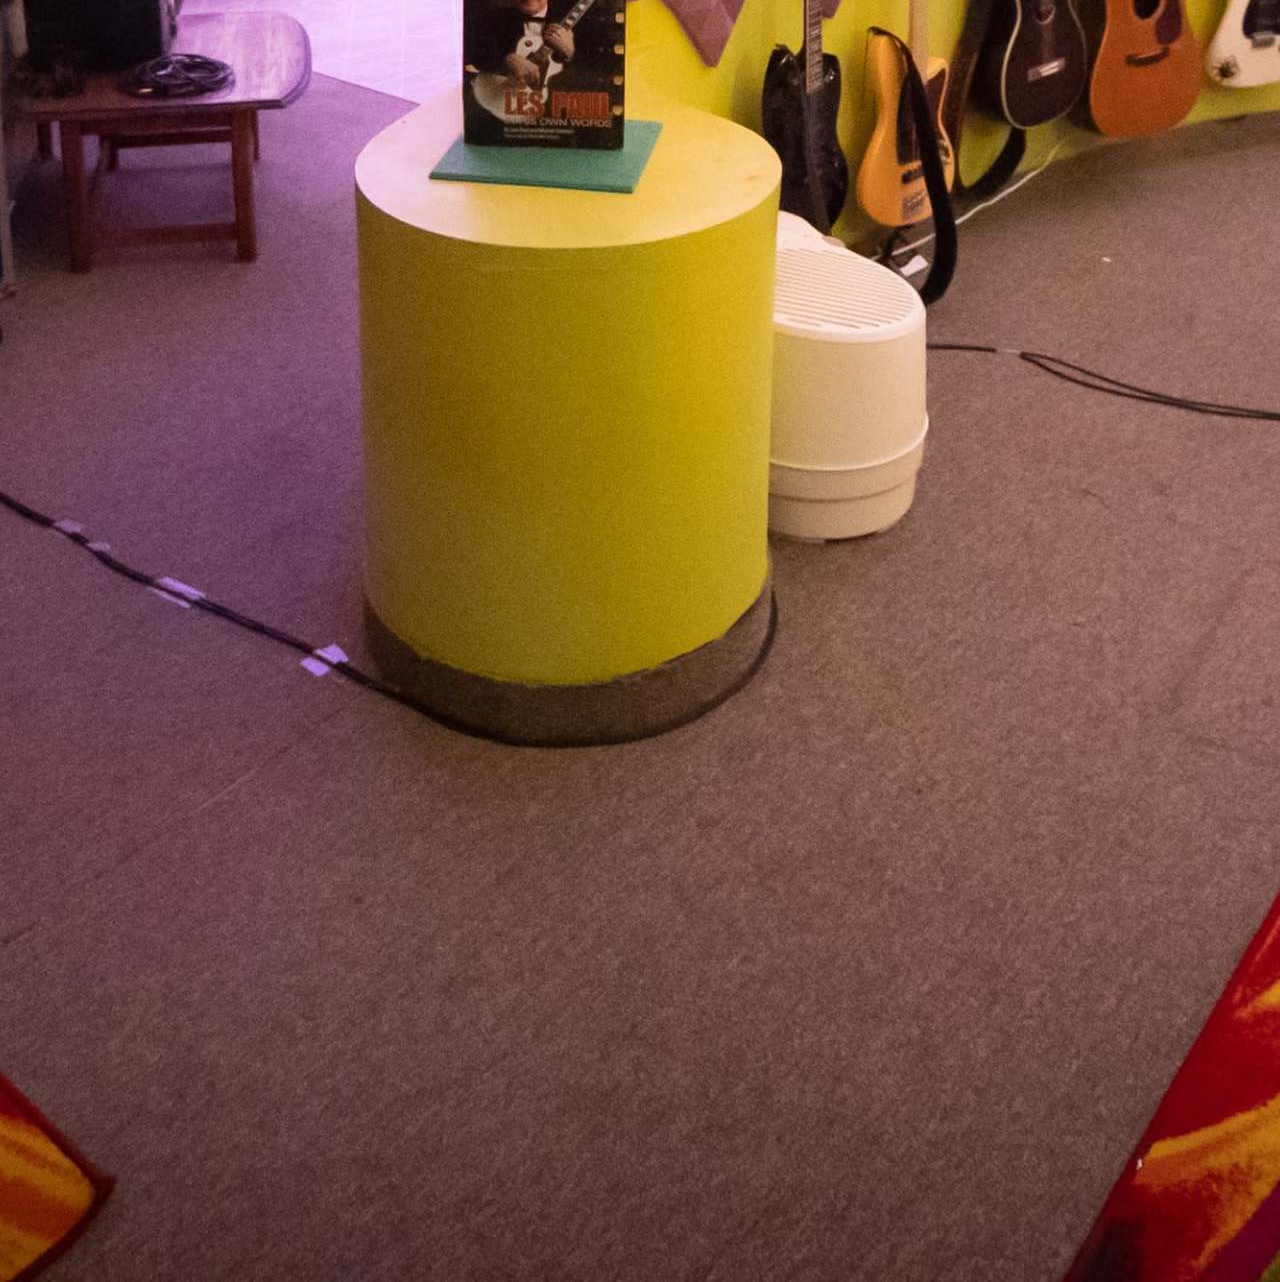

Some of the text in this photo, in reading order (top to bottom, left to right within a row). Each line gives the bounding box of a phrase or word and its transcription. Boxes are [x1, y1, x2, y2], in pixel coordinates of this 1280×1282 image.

[504, 91, 609, 119] LES PAUL
[539, 118, 568, 127] OWN
[570, 119, 612, 128] WORDS
